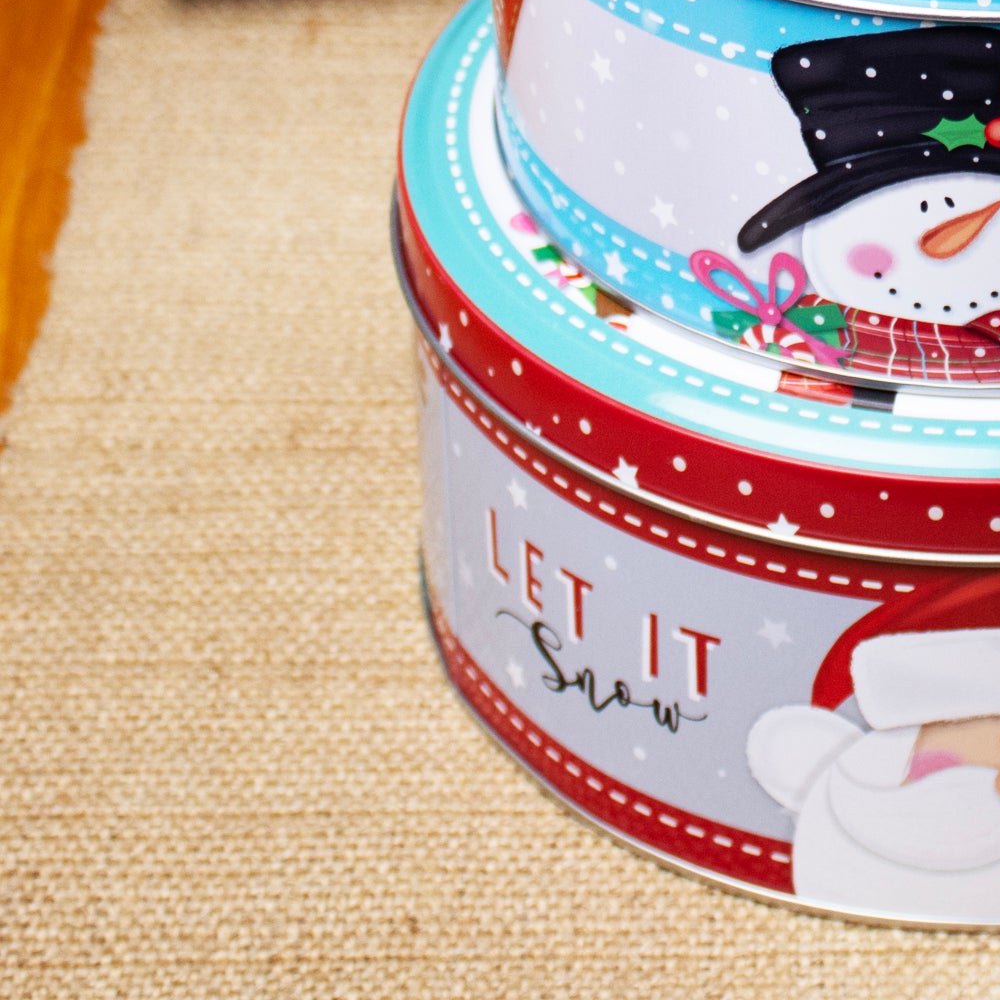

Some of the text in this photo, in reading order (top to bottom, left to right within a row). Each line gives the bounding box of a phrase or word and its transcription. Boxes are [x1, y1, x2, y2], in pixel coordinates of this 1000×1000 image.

[485, 507, 721, 702] LET IT
[496, 609, 708, 734] Snow
